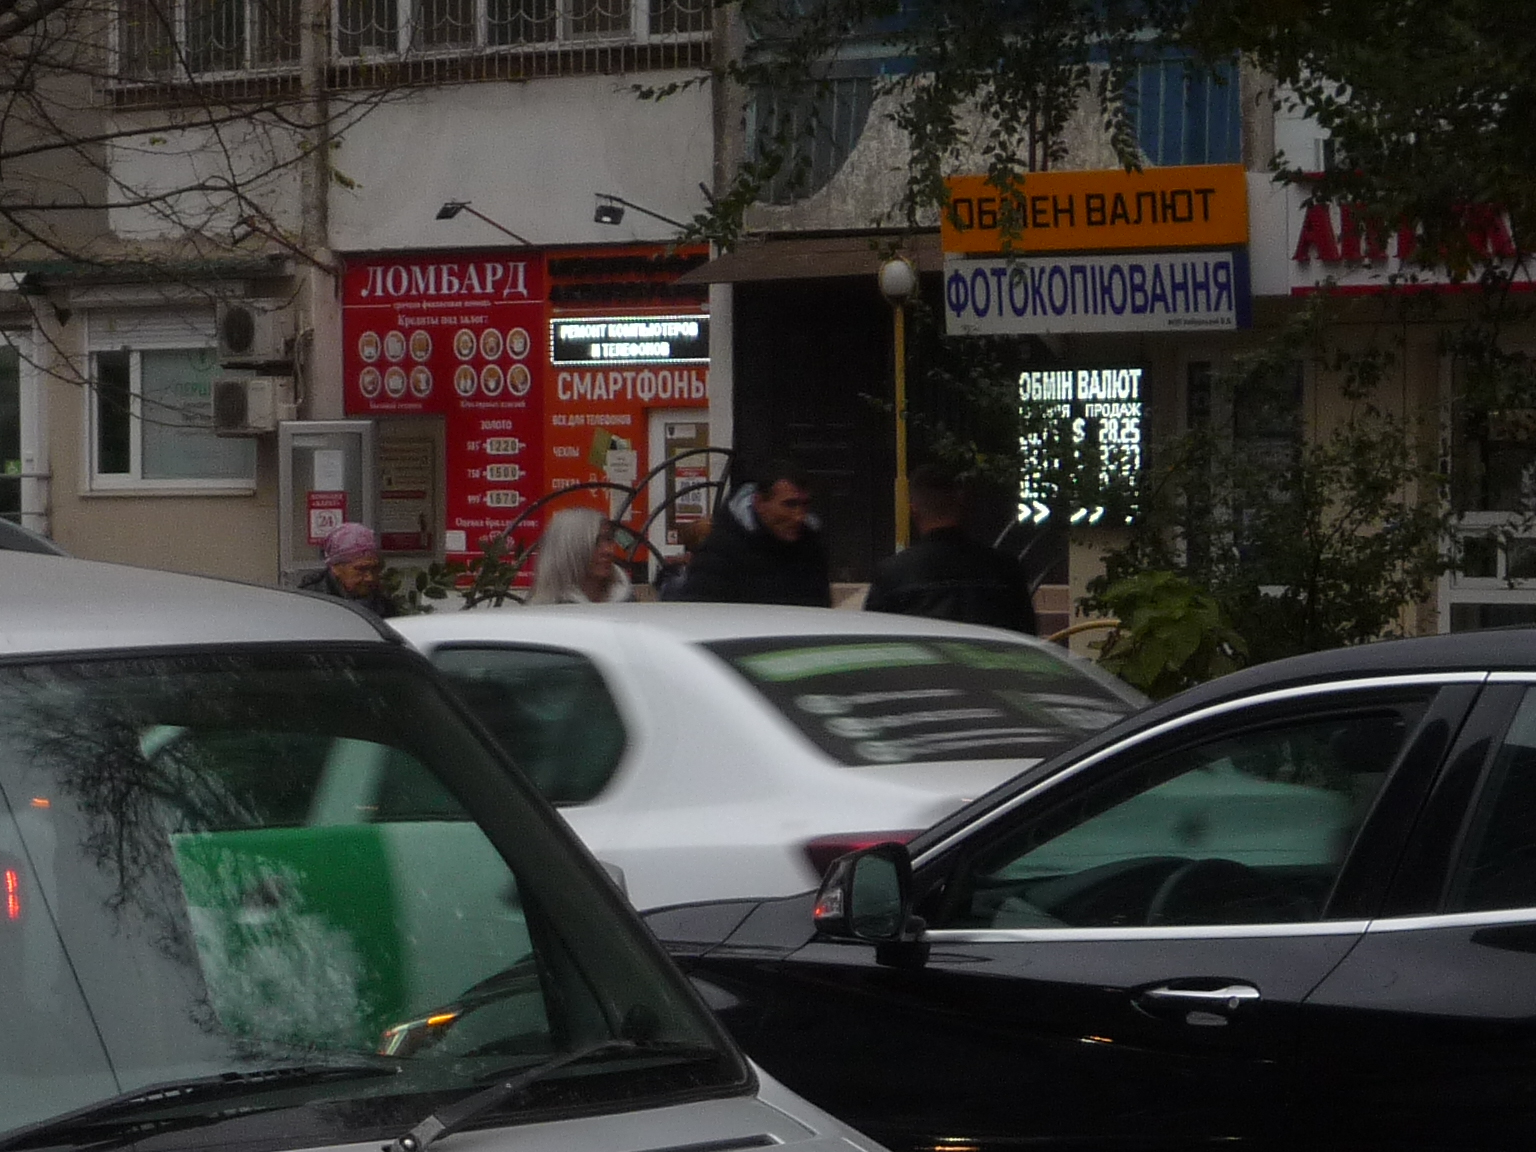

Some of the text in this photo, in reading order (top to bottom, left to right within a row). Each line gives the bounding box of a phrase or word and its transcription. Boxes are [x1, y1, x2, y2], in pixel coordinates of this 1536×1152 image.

[1085, 188, 1215, 227] ВАЛЮТ
[360, 261, 529, 299] ЛОМБАРД
[947, 261, 1233, 318] ФОТОКОПІЮВАННЯ
[560, 321, 699, 339] РЕМОНТ КОМПЬЮТЕРОВ
[602, 341, 670, 358] ТЕЛЕФОНОВ
[1019, 368, 1143, 401] ОБМІН ВАЛЮТ
[1085, 402, 1143, 418] ПРОДАЖ
[479, 419, 512, 430] ЗОЛОТО
[1072, 417, 1085, 443] $
[1099, 417, 1141, 444] 28.25
[552, 446, 580, 458] ЧЕХЛЫ
